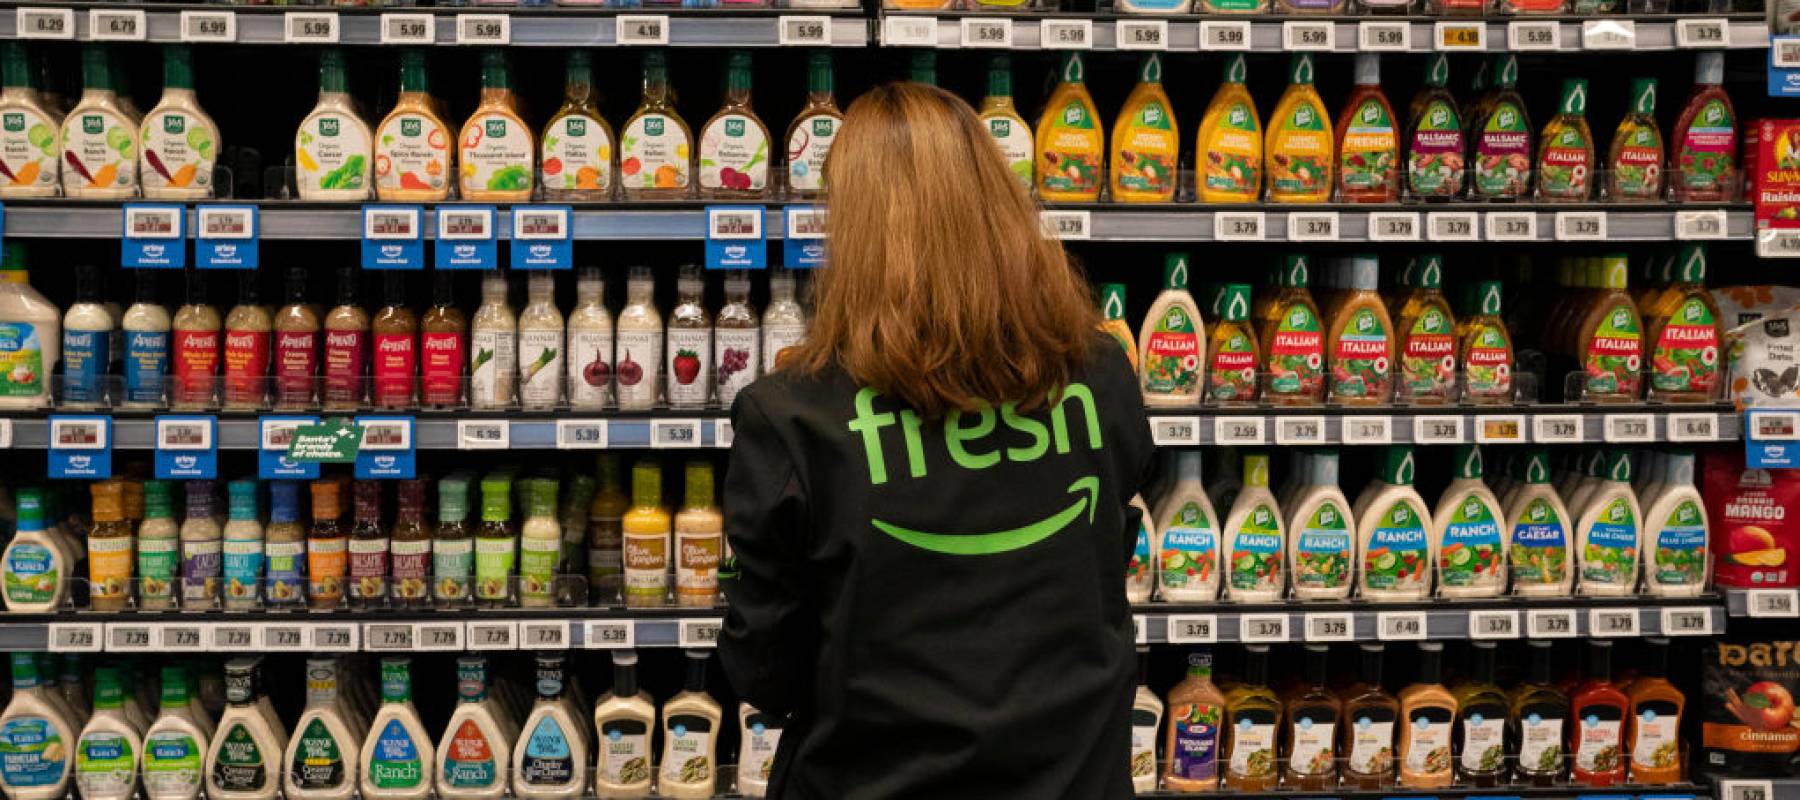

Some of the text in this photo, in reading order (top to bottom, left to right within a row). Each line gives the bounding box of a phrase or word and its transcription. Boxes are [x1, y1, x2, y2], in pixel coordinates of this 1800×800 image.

[304, 23, 329, 34] 5.99
[401, 23, 426, 34] 5.99
[477, 26, 502, 36] 5.99
[637, 26, 660, 36] 4.18
[798, 26, 822, 38] 5.99
[980, 28, 1004, 40] 5.99
[1060, 30, 1084, 41] 5.99
[1136, 30, 1160, 41] 5.99
[1218, 31, 1242, 42] 5.99
[1302, 31, 1327, 42] 5.99
[1378, 32, 1402, 43] 5.99
[1528, 31, 1552, 42] 5.99
[1345, 136, 1392, 146] FRENCH
[1418, 133, 1459, 142] BALSAMIC
[1484, 134, 1526, 142] BALSAMIC
[1548, 153, 1584, 162] ITALIAN
[1622, 152, 1658, 160] ITALIAN
[1060, 221, 1082, 232] 3.79
[1234, 222, 1257, 233] 3.79
[1308, 222, 1330, 233] 3.79
[1390, 222, 1412, 234] 3.79
[1448, 222, 1470, 234] 3.79
[1506, 222, 1529, 232] 3.79
[1576, 222, 1598, 232] 3.79
[1666, 328, 1714, 340] ITALIAN
[1152, 340, 1195, 351] ITALIAN
[1276, 335, 1320, 346] ITALIAN
[1596, 339, 1638, 350] ITALIAN
[1342, 342, 1385, 353] ITALIAN
[1410, 342, 1452, 352] ITALIAN
[1218, 354, 1253, 364] ITALIAN
[1472, 352, 1507, 360] ITALIAN
[576, 430, 600, 441] 5.39
[670, 429, 693, 440] 5.39
[1170, 426, 1191, 437] 3.79
[1234, 426, 1256, 437] 2.59
[1434, 425, 1456, 436] 3.79
[1554, 425, 1576, 436] 3.79
[298, 436, 338, 444] Santa's
[1725, 504, 1785, 520] MANGO
[1377, 531, 1422, 543] RANCH
[1450, 526, 1495, 538] RANCH
[1518, 530, 1559, 540] CAESAR
[1592, 532, 1610, 540] BLUE
[1169, 536, 1210, 546] RANCH
[1240, 536, 1278, 546] RANCH
[1305, 537, 1344, 548] RANCH
[1661, 536, 1680, 544] BLUE
[1324, 622, 1346, 634] 3.79
[1490, 620, 1512, 631] 3.79
[1548, 620, 1570, 630] 3.79
[1611, 618, 1632, 628] 3.79
[1682, 618, 1704, 628] 3.79
[1187, 624, 1209, 635] 3.79
[1260, 624, 1282, 634] 3.79
[70, 632, 92, 644] 7.79
[127, 632, 149, 644] 7.79
[177, 632, 200, 644] 7.79
[228, 632, 250, 644] 7.79
[278, 632, 300, 644] 7.79
[328, 632, 350, 644] 7.79
[384, 632, 406, 644] 7.79
[434, 632, 456, 644] 7.79
[487, 632, 509, 644] 7.79
[540, 632, 562, 644] 7.79
[604, 630, 626, 640] 5.39
[375, 764, 416, 779] Ranch
[452, 768, 487, 781] Ranch
